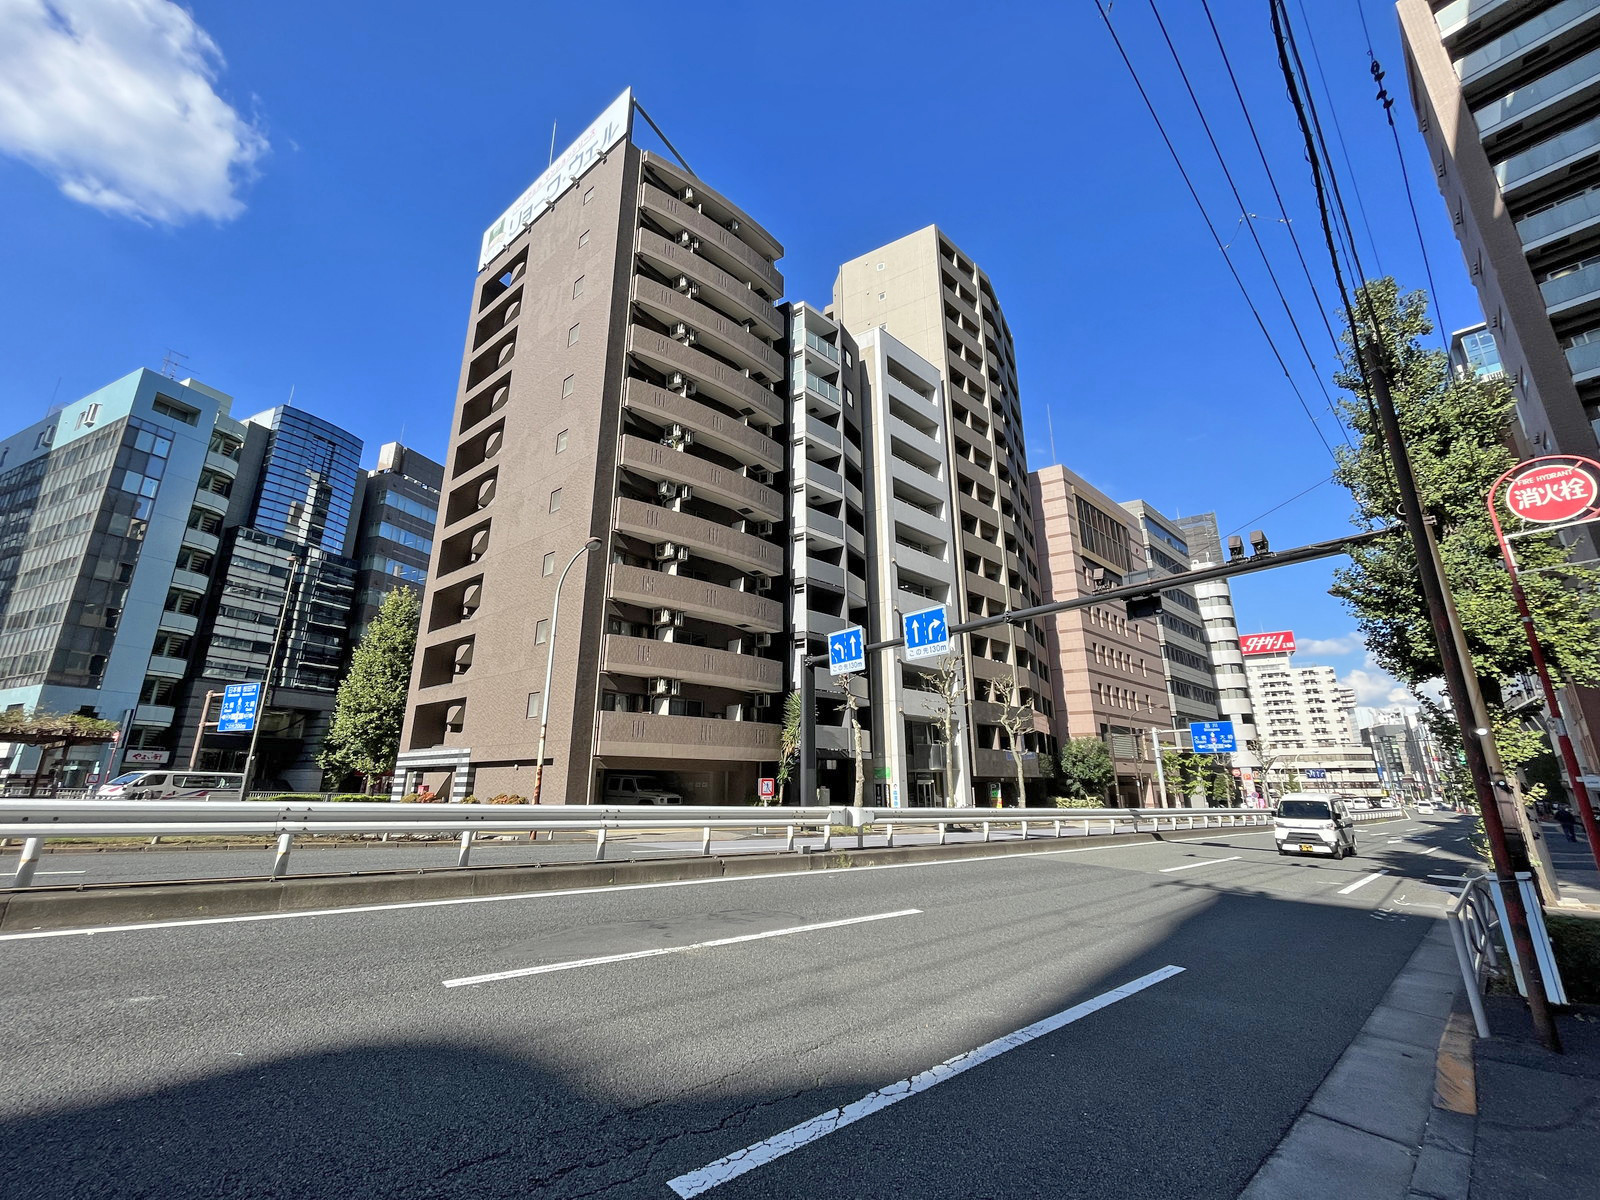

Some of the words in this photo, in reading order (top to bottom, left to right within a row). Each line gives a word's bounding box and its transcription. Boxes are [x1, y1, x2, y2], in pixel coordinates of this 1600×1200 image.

[1518, 477, 1534, 486] FIRE
[1536, 470, 1572, 482] HYDRANT
[1514, 478, 1588, 510] 消火栓
[909, 645, 947, 657] この先130m
